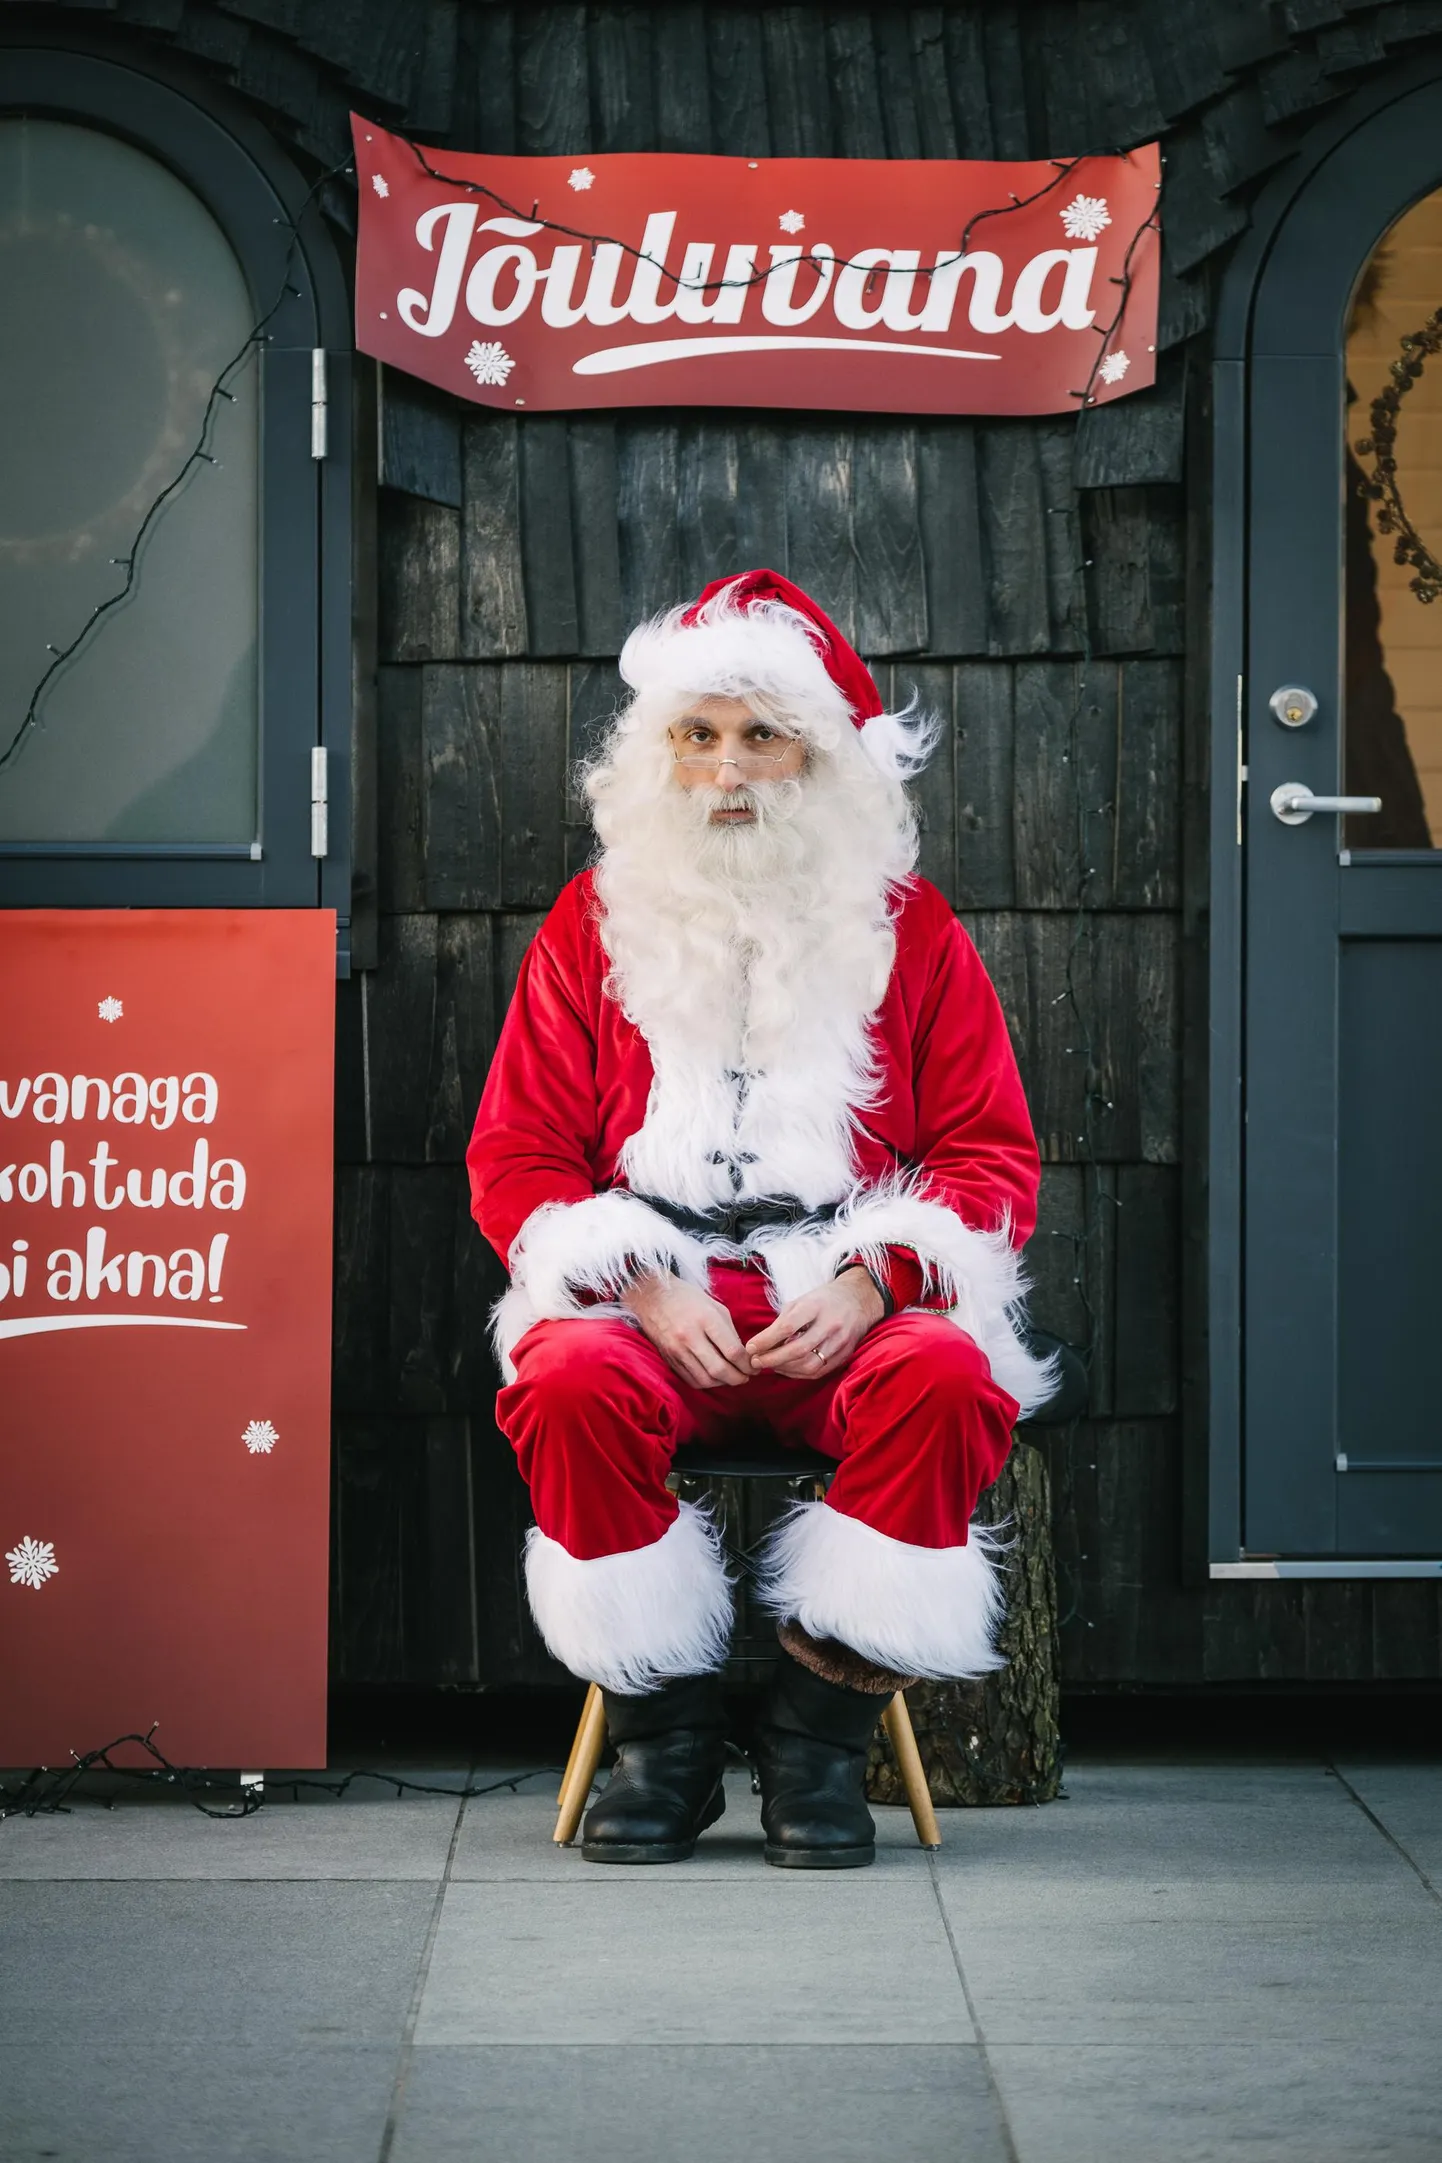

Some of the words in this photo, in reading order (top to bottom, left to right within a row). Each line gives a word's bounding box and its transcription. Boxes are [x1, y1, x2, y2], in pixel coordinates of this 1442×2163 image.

[396, 202, 1098, 338] Jõuluvana
[0, 1072, 219, 1131] vanaga
[0, 1137, 247, 1211] ohtuda
[0, 1239, 29, 1302] i
[46, 1226, 230, 1303] akna!
